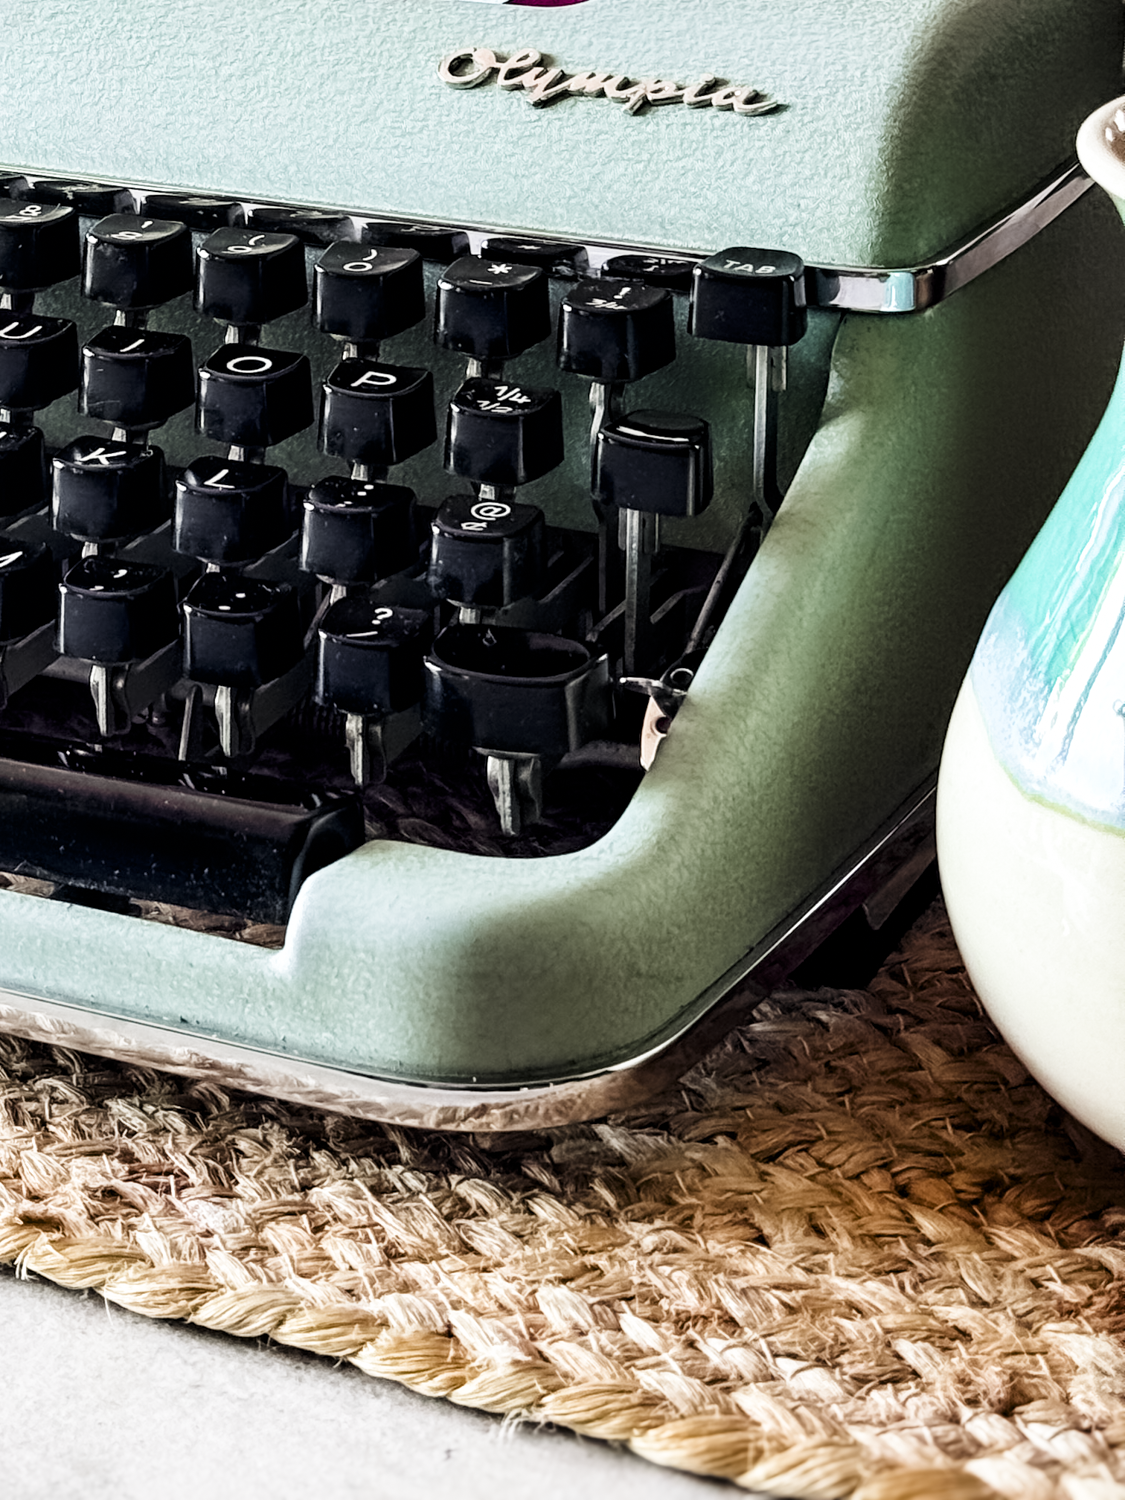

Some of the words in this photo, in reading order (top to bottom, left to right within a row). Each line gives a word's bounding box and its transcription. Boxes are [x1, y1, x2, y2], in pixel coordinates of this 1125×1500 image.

[438, 48, 787, 116] Olympia
[724, 259, 777, 274] TAB
[226, 355, 273, 373] O
[351, 372, 396, 386] P
[77, 447, 126, 466] K
[204, 468, 235, 489] L
[471, 502, 510, 520] @
[372, 608, 392, 624] ?
